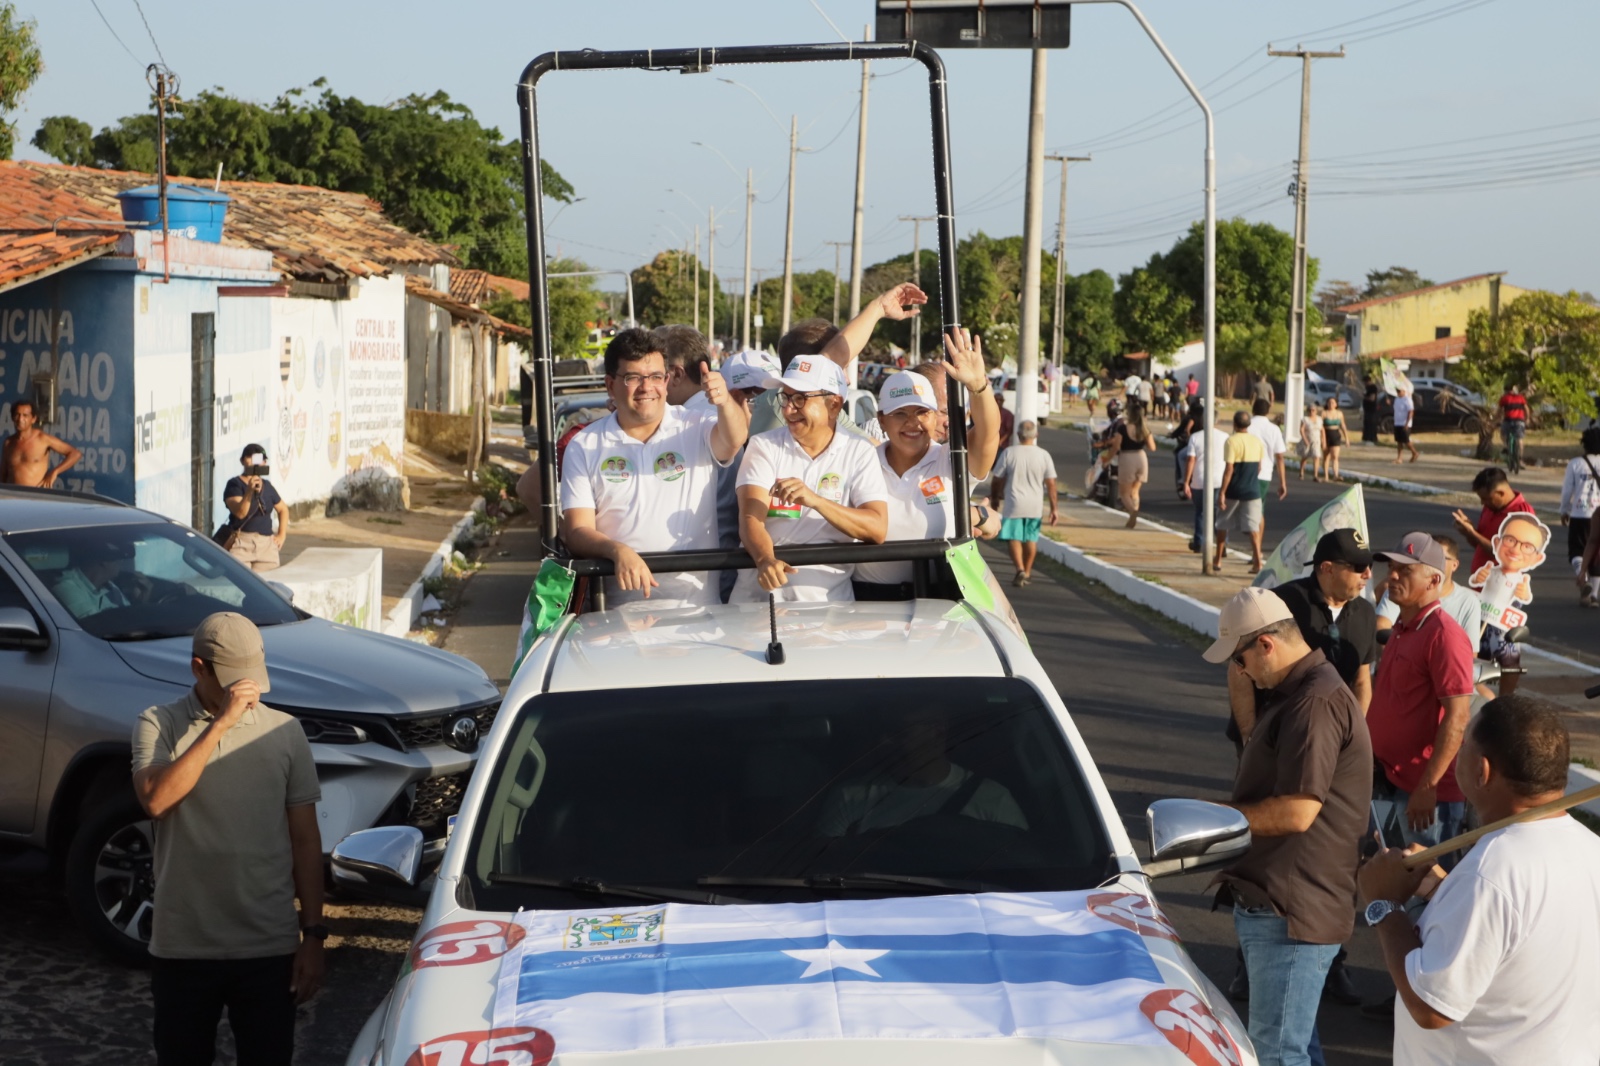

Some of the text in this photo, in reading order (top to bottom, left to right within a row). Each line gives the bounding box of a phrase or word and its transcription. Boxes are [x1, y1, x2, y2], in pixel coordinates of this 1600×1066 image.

[355, 319, 396, 338] CENTRAL DE
[349, 340, 401, 361] MONOGRAFIAS
[17, 349, 116, 402] MAIO
[1504, 610, 1520, 627] 15
[418, 921, 509, 962] 15
[1153, 991, 1239, 1066] 15
